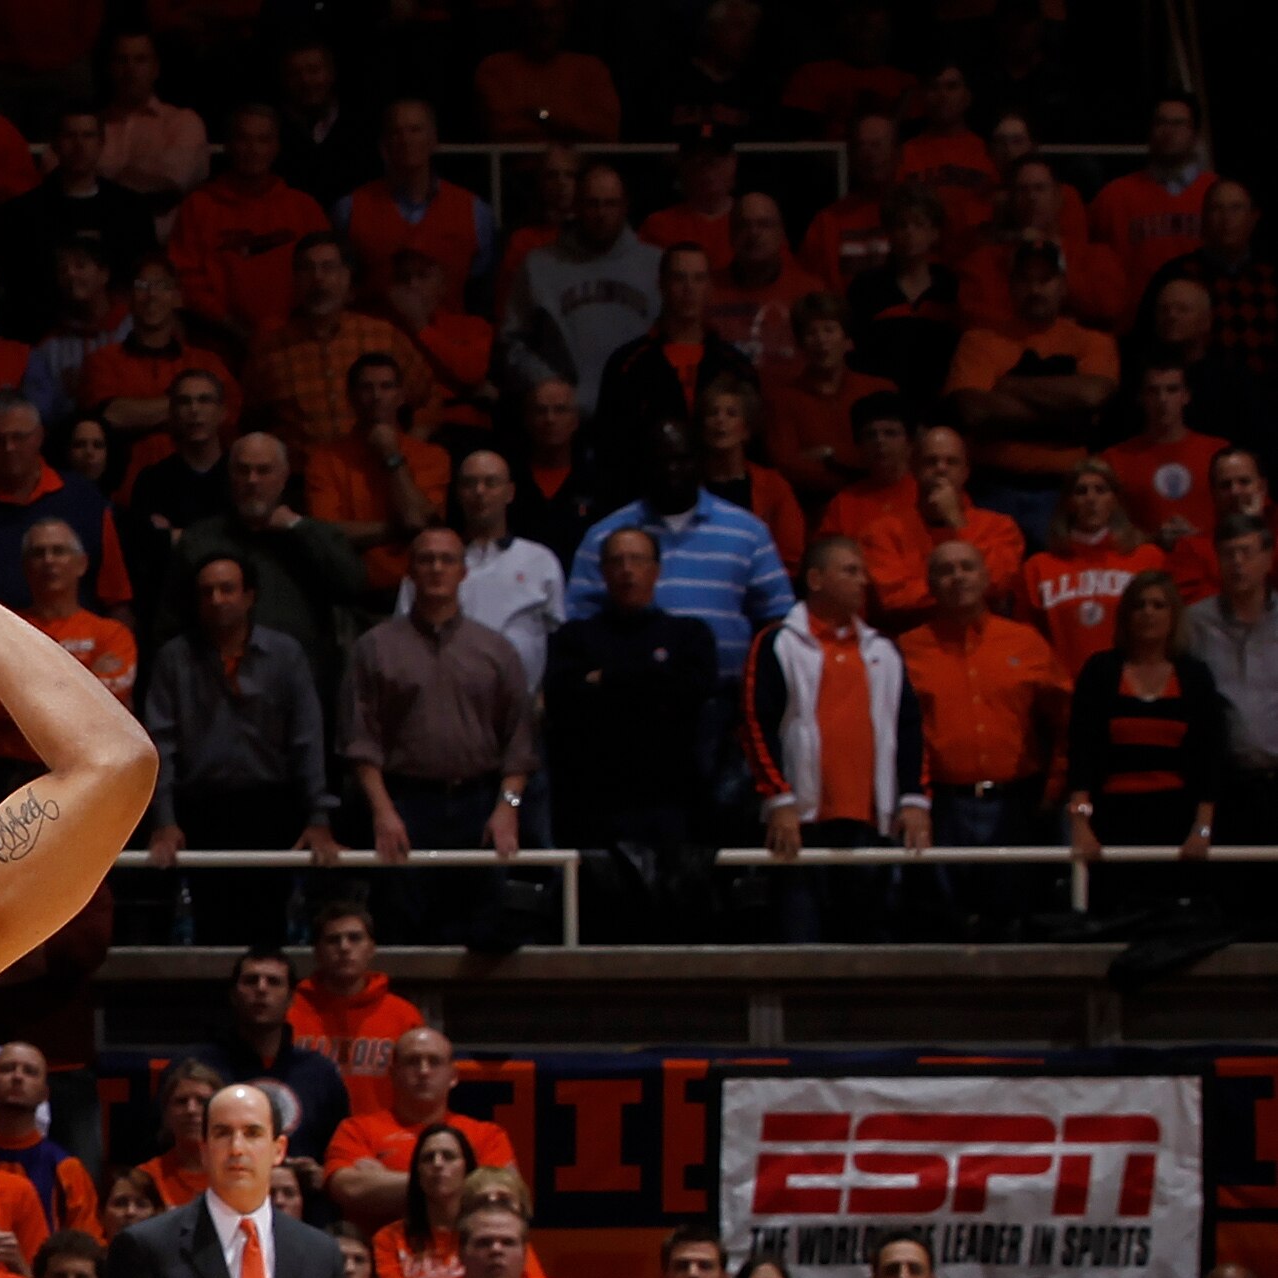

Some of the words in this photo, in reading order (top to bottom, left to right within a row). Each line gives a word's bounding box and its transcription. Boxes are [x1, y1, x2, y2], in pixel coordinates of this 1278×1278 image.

[751, 1112, 1162, 1217] ESPN
[750, 1226, 788, 1264] THE
[943, 1224, 1022, 1265] LEADER
[1029, 1227, 1055, 1266] IN
[1061, 1227, 1152, 1267] SPORTS
